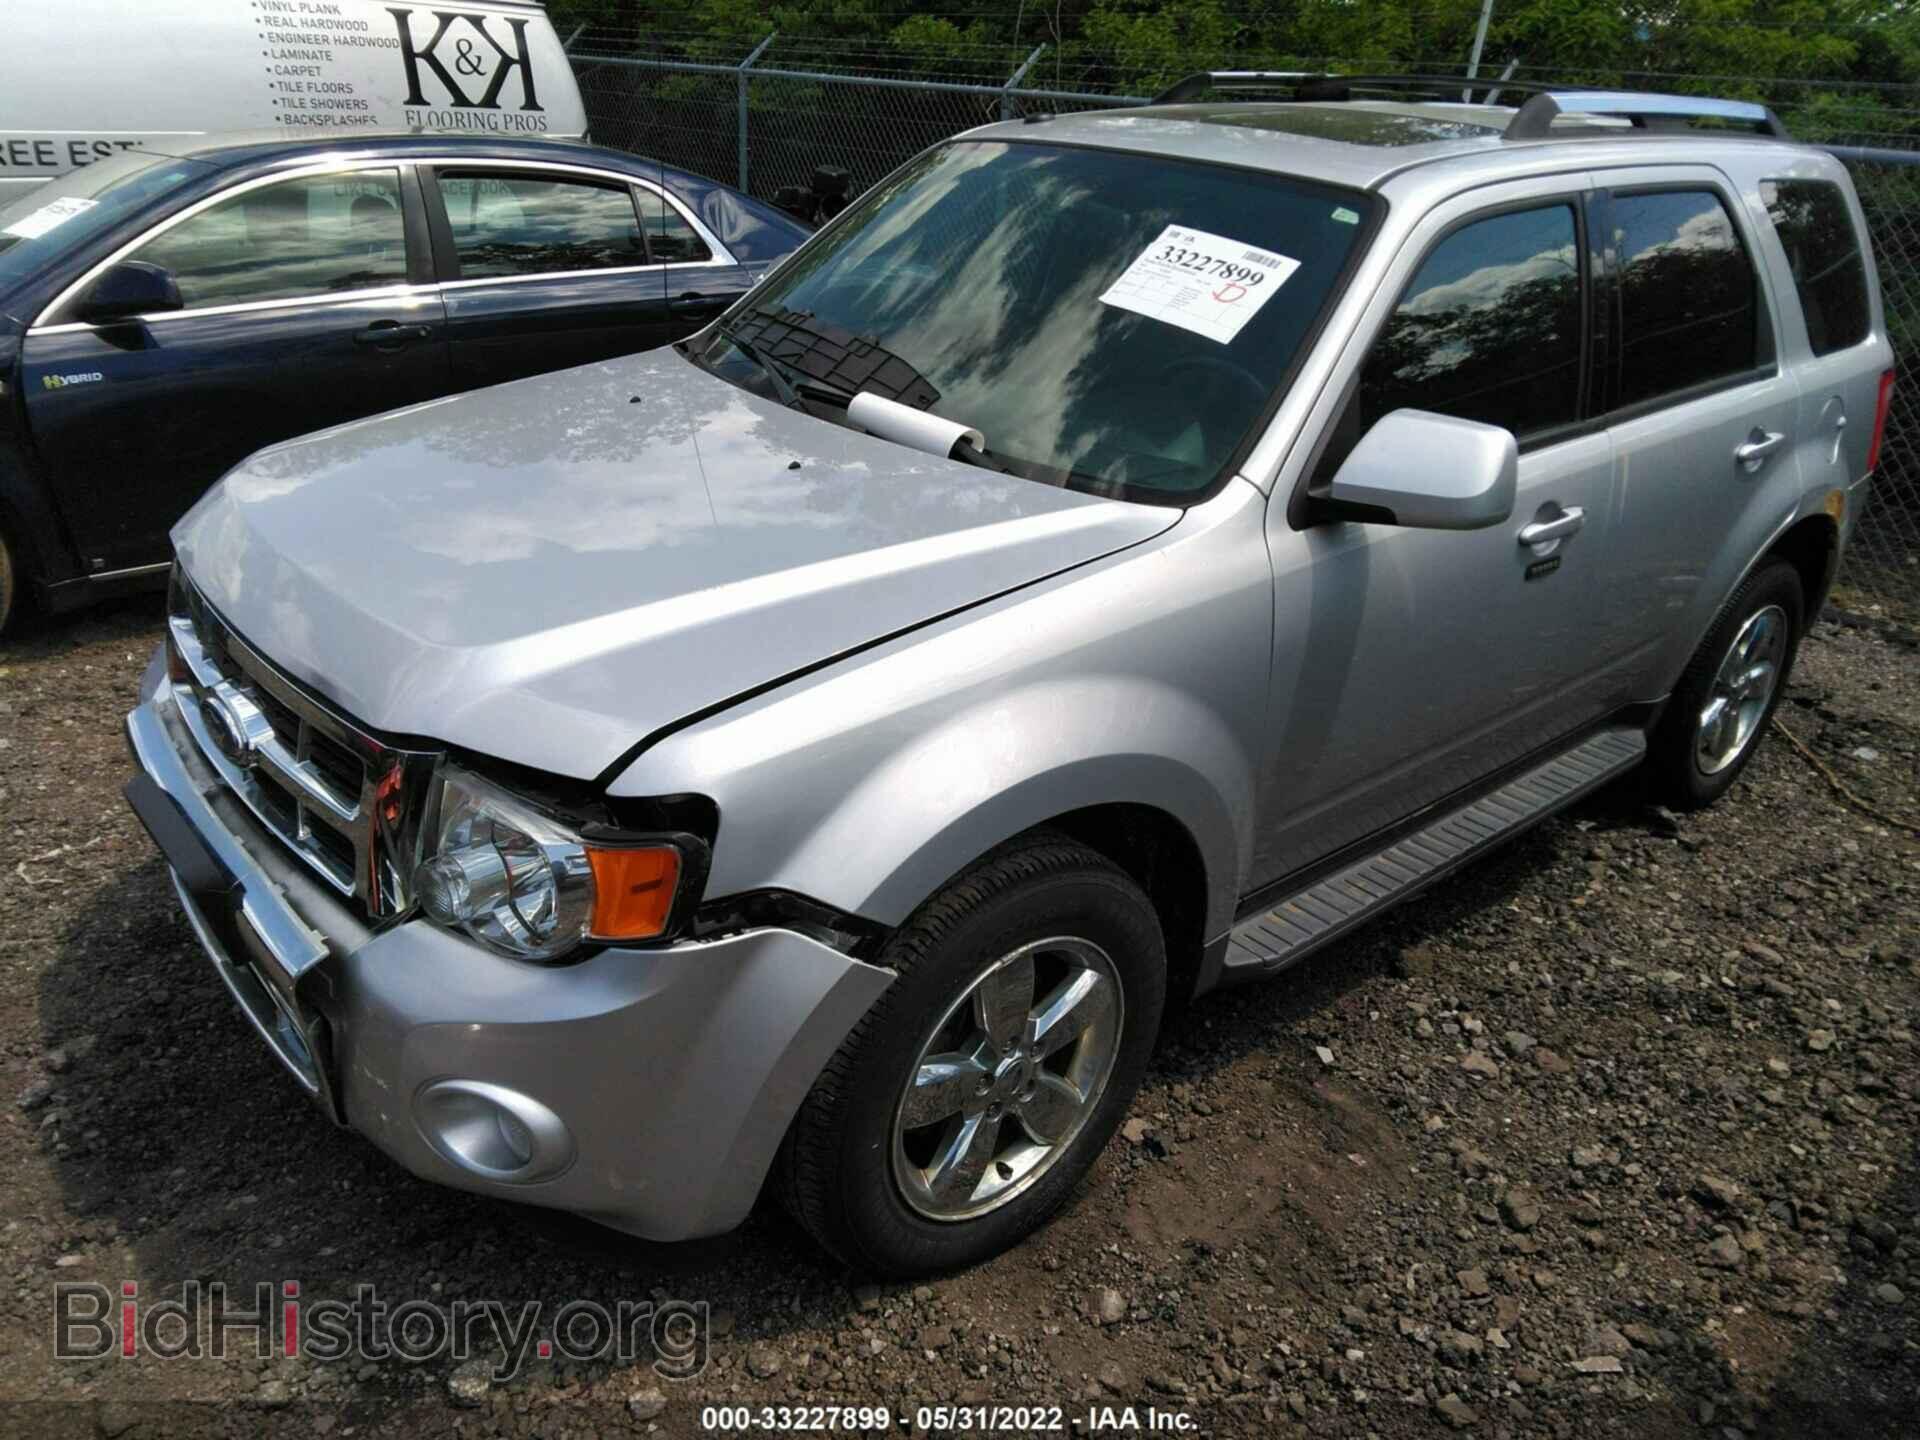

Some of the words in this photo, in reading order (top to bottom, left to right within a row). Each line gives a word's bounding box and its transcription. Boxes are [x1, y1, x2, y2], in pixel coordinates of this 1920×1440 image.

[256, 0, 297, 12] VINYL
[300, 2, 342, 15] PLANK
[264, 15, 297, 28] REAL
[300, 18, 369, 31] HARDWOOD
[267, 31, 330, 45] ENGINEER
[333, 35, 400, 48] HARDWOOD
[271, 49, 333, 62] LAMINATE
[274, 65, 322, 77] CARPET
[277, 80, 303, 93] TILE
[307, 82, 354, 94] FLOORS
[280, 97, 306, 109] TILE
[310, 98, 369, 111] SHOWERS
[405, 110, 498, 132] FLOORING
[503, 114, 548, 133] PROS
[1155, 245, 1266, 287] 33227899
